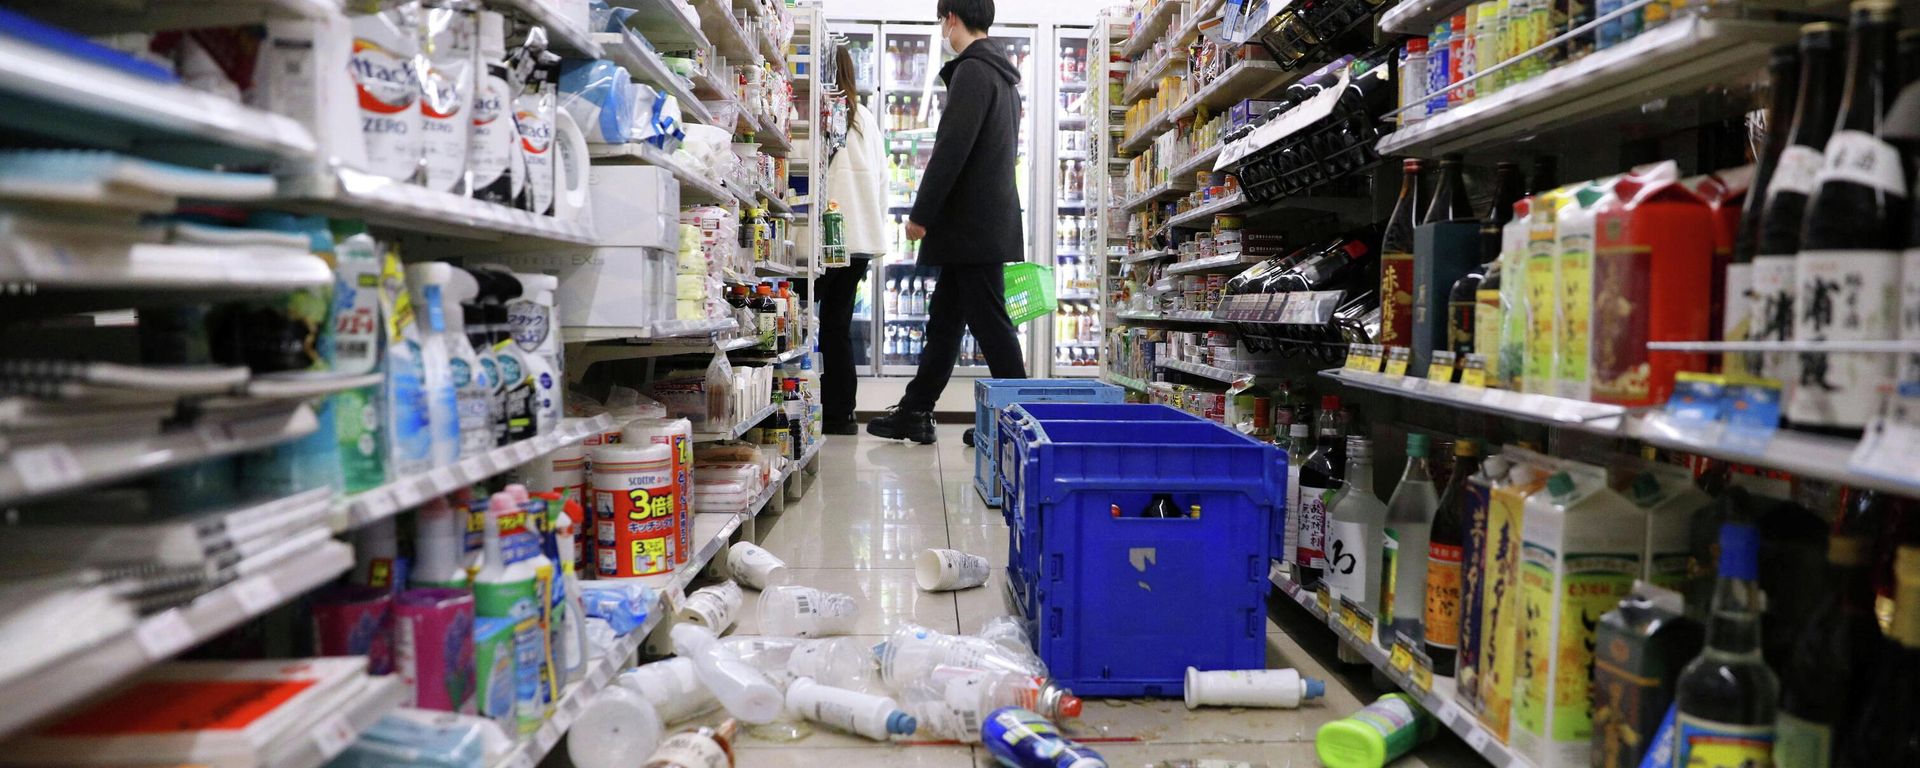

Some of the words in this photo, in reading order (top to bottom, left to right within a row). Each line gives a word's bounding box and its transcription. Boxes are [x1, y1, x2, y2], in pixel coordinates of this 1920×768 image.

[474, 97, 500, 111] ack
[362, 117, 407, 134] ZERO
[628, 475, 656, 486] scottie
